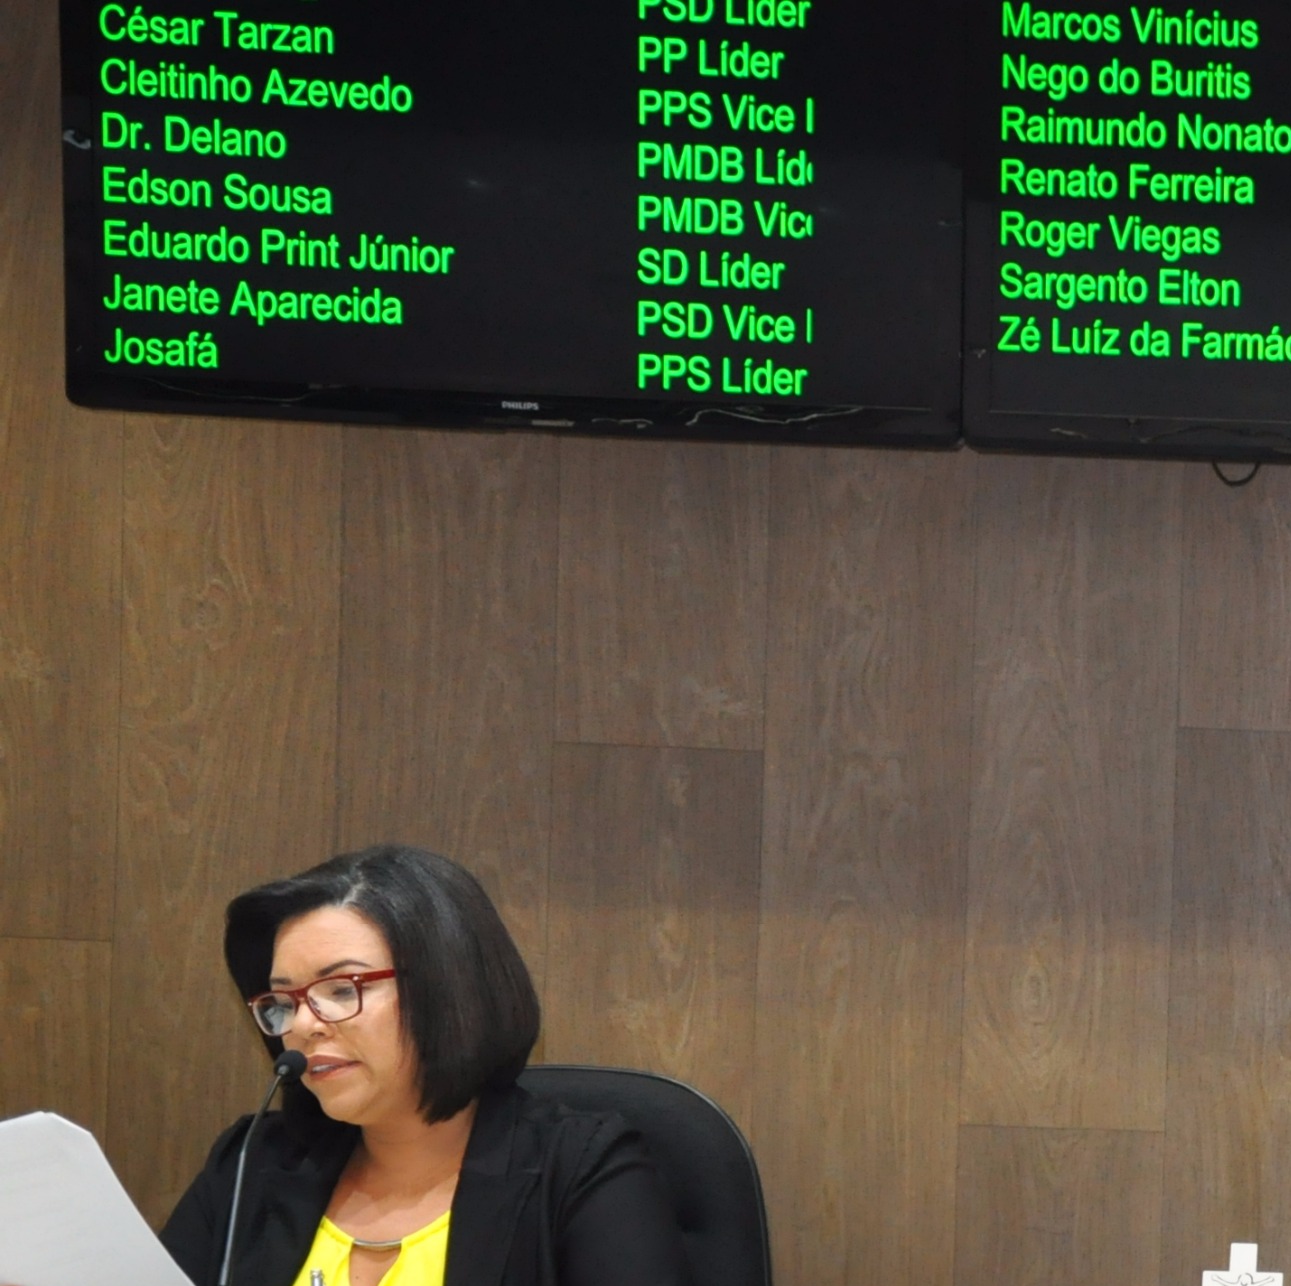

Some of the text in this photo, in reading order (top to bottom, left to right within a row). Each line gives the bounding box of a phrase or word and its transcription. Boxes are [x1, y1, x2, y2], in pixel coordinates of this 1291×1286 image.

[99, 3, 334, 55] César Tarzan
[1002, 1, 1259, 48] Marcos Vinícius
[638, 35, 785, 80] PP Líder
[1002, 53, 1252, 101] Nego do Buritis
[100, 57, 413, 113] Cleitinho Azevedo
[638, 88, 713, 129] PPS
[721, 93, 796, 134] Vice
[1001, 105, 1168, 149] Raimundo
[101, 111, 287, 159] Dr. Delano
[637, 141, 814, 187] PMDB Líd
[1000, 158, 1255, 205] Renato Ferreira
[102, 165, 333, 215] Edson Sousa
[637, 194, 814, 240] PMDB Vic
[1000, 210, 1222, 263] Roger Viegas
[103, 219, 455, 274] Eduardo Print Júnior
[636, 246, 786, 290] SD Líder
[103, 273, 403, 327] Janete Aparecida
[999, 261, 1241, 311] Sargento Elton
[637, 300, 714, 340] PSD
[722, 303, 796, 344] Vice
[997, 315, 1042, 353] Zé
[1051, 317, 1121, 356] Luíz
[1129, 320, 1171, 358] da
[104, 327, 219, 369] Josafá
[637, 352, 809, 396] PPS Líder
[501, 400, 539, 411] PHILIPS
